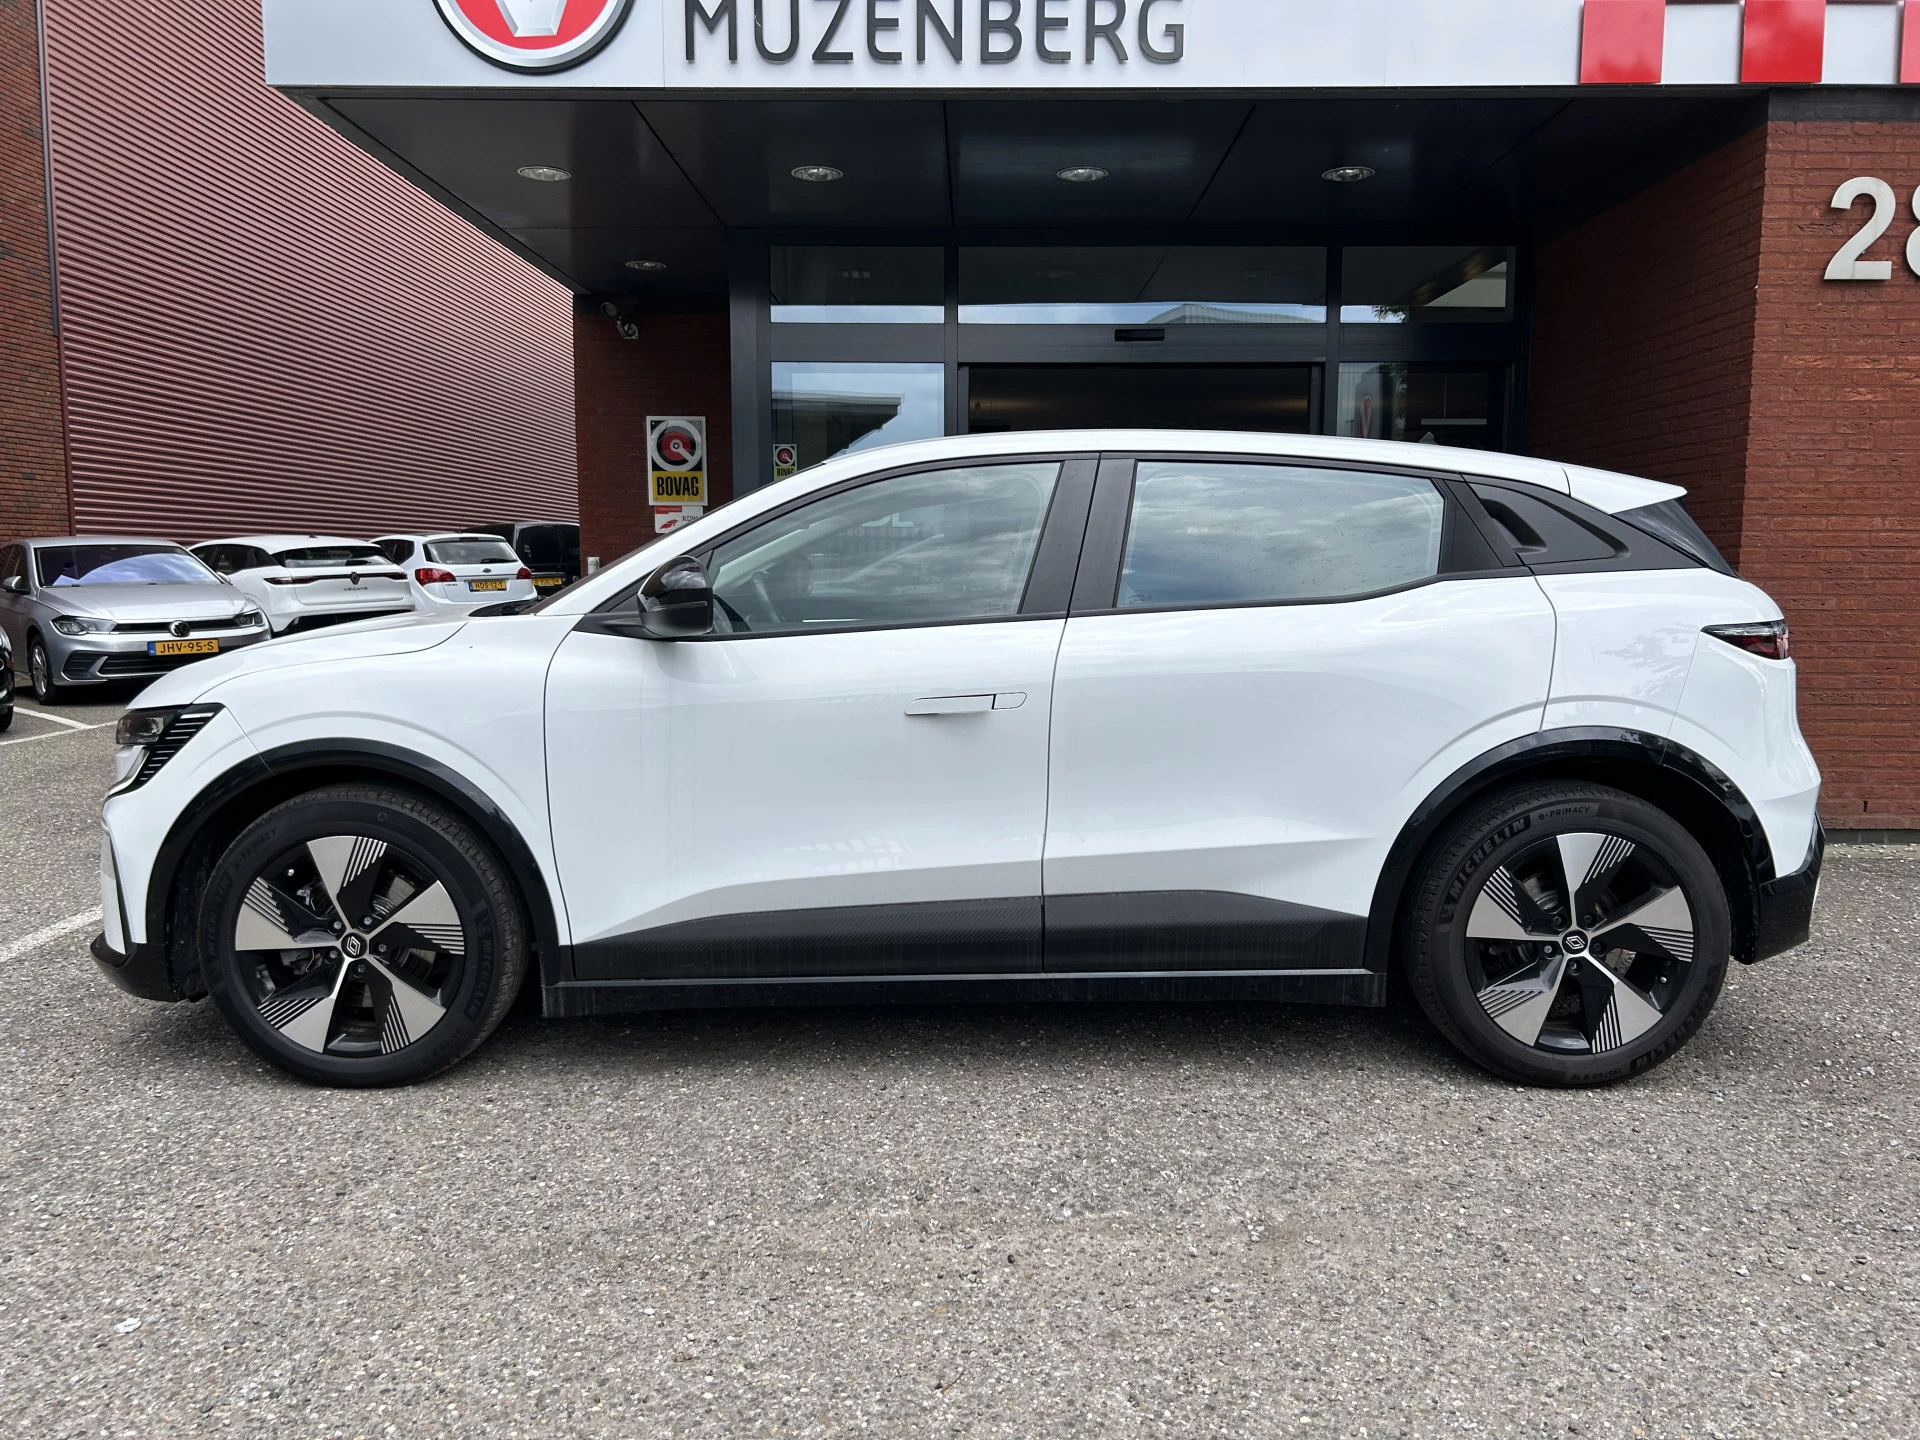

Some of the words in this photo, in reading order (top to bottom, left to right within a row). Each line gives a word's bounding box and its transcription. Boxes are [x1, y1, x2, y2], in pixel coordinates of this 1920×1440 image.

[685, 0, 1185, 62] MUZENBERG
[1824, 176, 1920, 280] 2
[656, 476, 699, 496] BOVAG
[160, 641, 214, 654] JHV-95-S
[1449, 817, 1525, 899] MICHELIN
